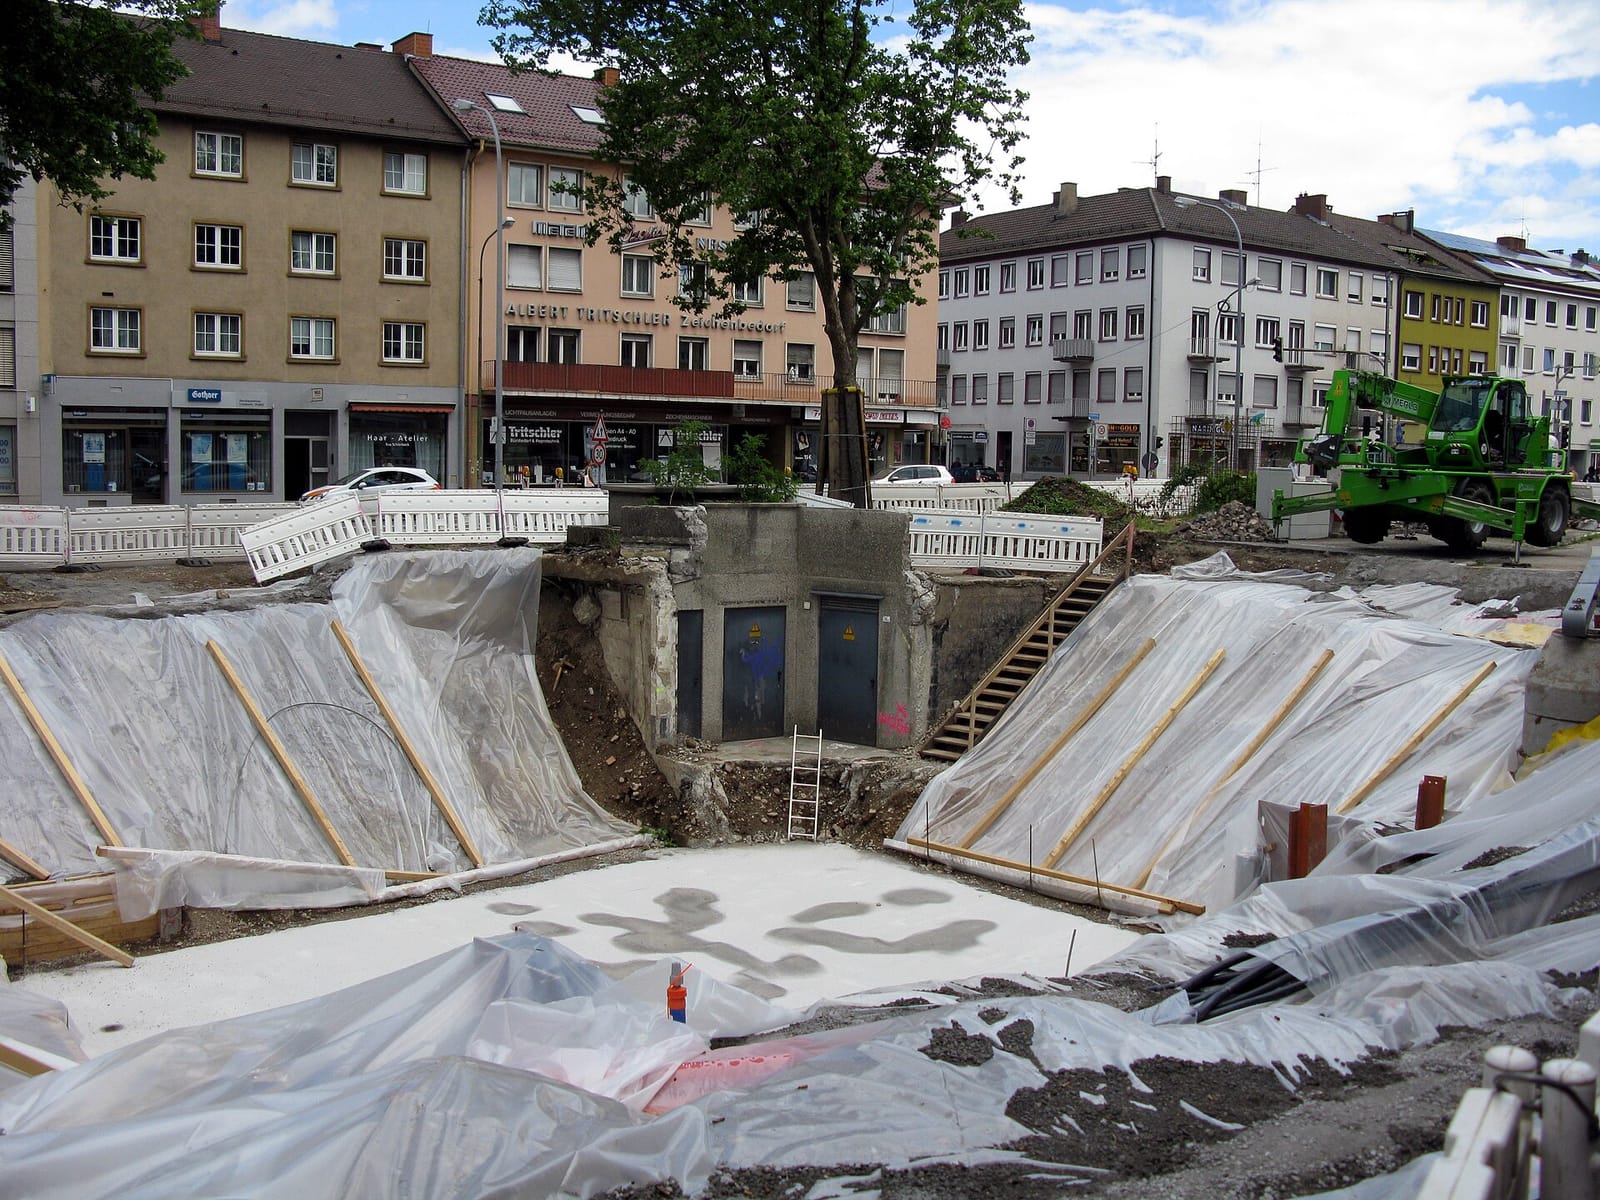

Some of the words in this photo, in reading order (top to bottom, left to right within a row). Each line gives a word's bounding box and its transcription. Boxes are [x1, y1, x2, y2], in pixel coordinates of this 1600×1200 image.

[505, 303, 569, 320] ALBERT
[577, 307, 672, 327] TRITSCHLER
[191, 390, 218, 400] Gothaer
[508, 426, 563, 439] Tritschler
[1119, 425, 1138, 433] GOLD
